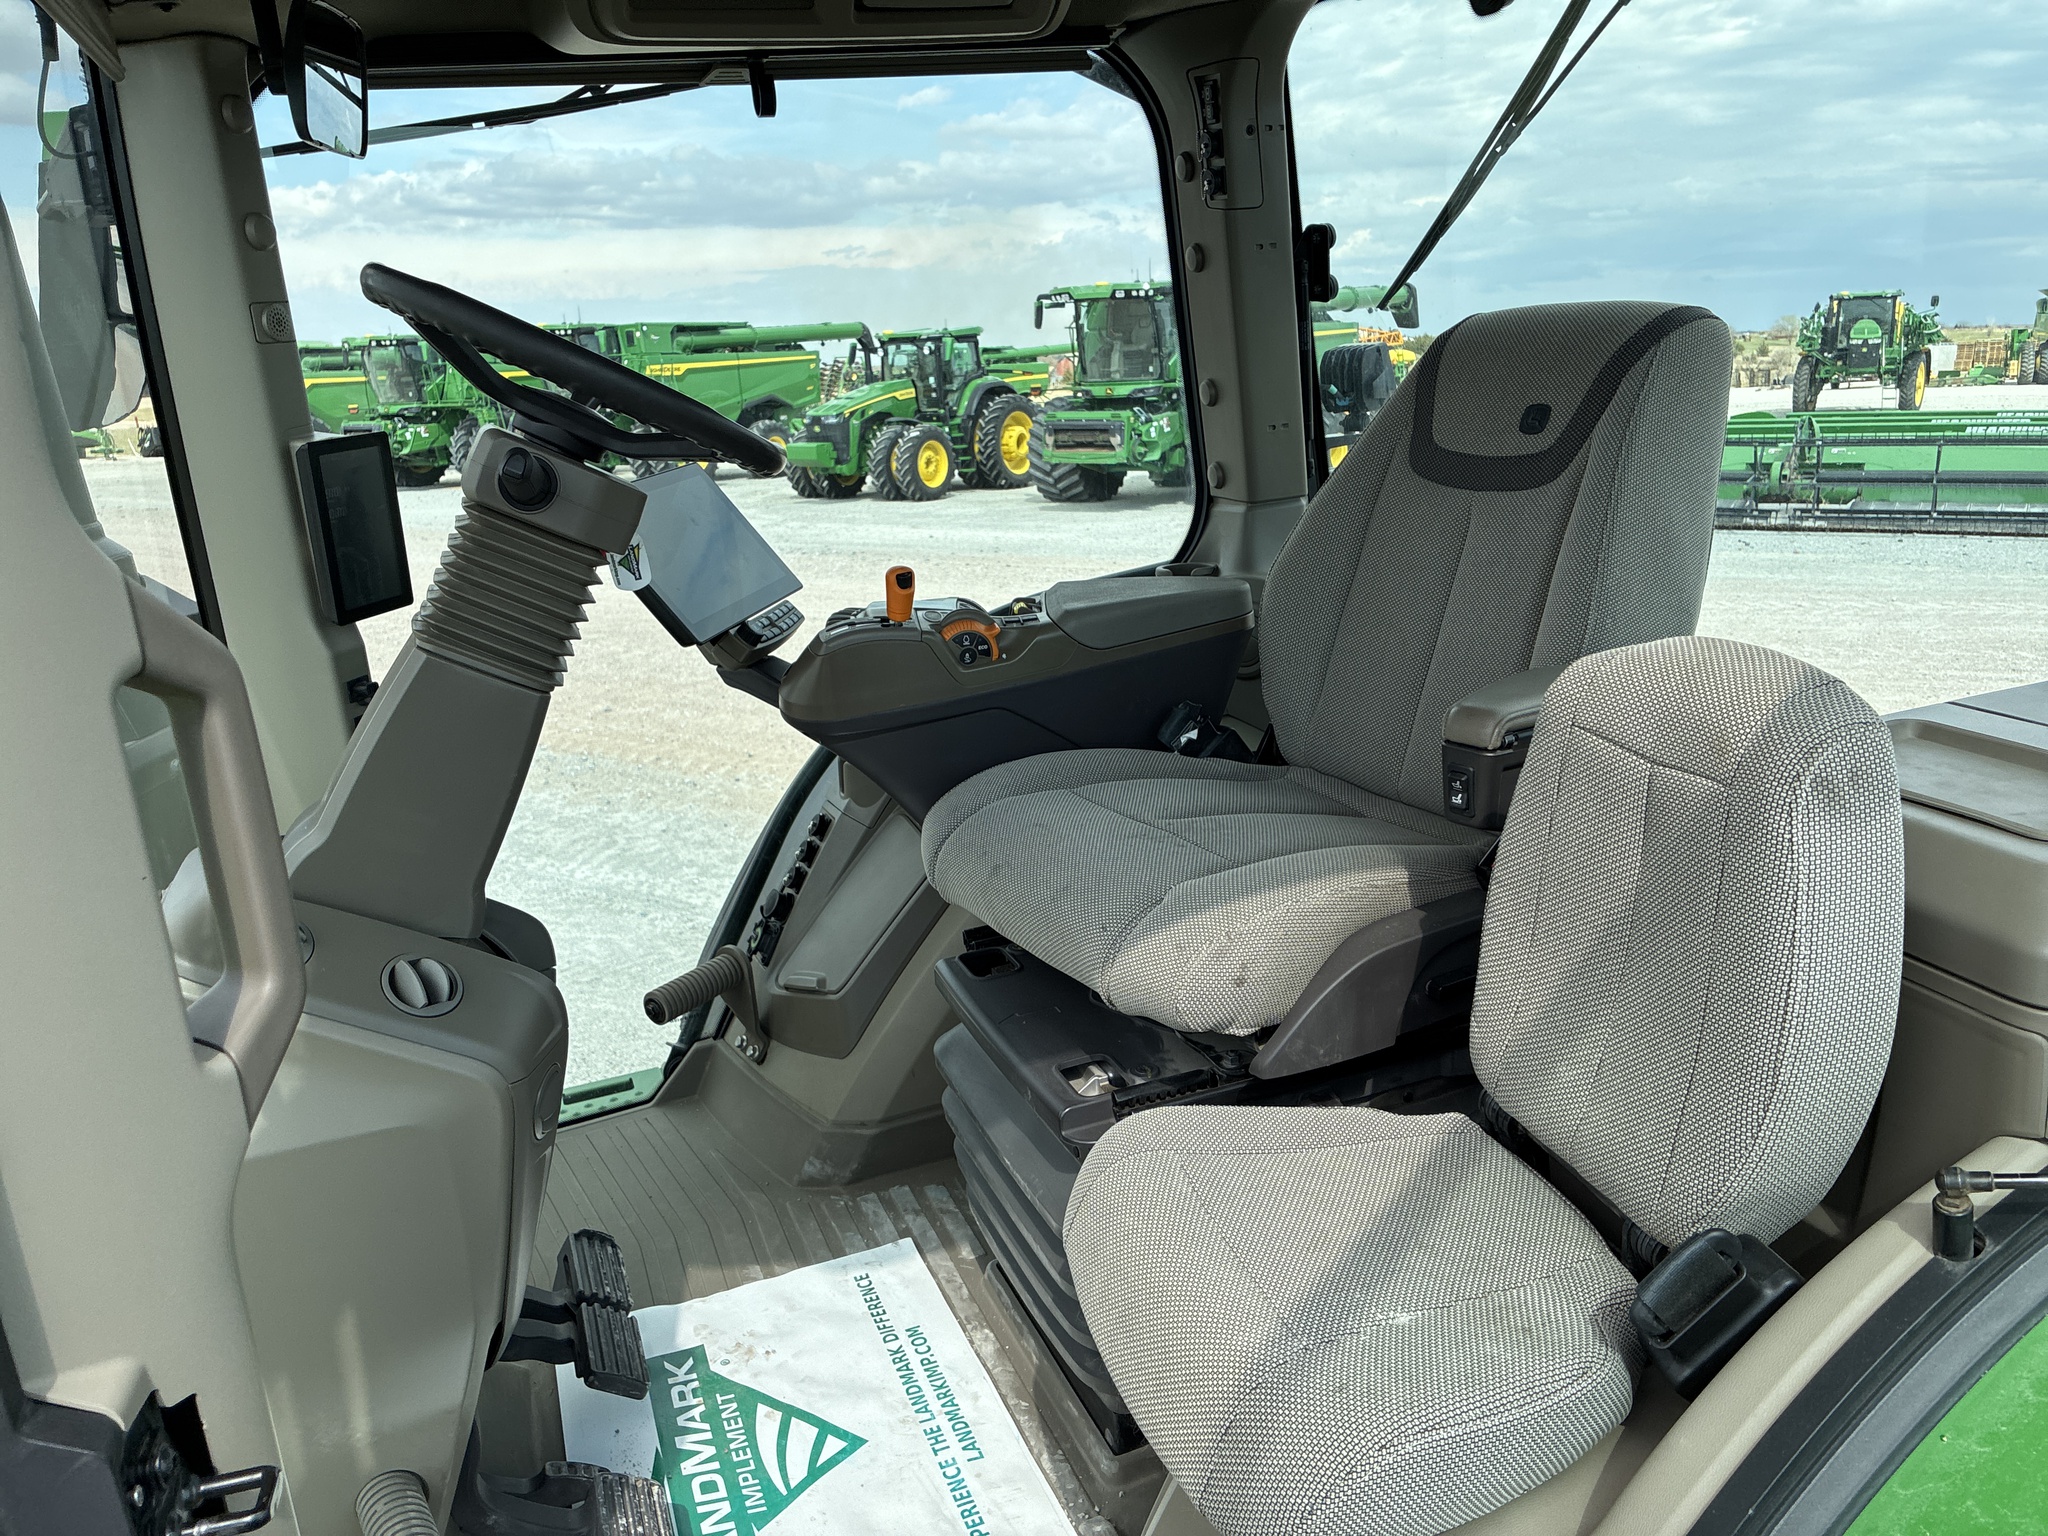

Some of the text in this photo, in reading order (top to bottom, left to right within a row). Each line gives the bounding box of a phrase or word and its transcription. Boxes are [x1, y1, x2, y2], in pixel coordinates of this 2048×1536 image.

[853, 1273, 899, 1344] DIFFERENCE
[887, 1344, 936, 1424] LANDMARK
[905, 1325, 984, 1462] LANDMARKIMP.COM
[664, 1356, 738, 1536] NDMARK
[716, 1393, 767, 1514] IMPLEMENT
[923, 1425, 950, 1456] THE
